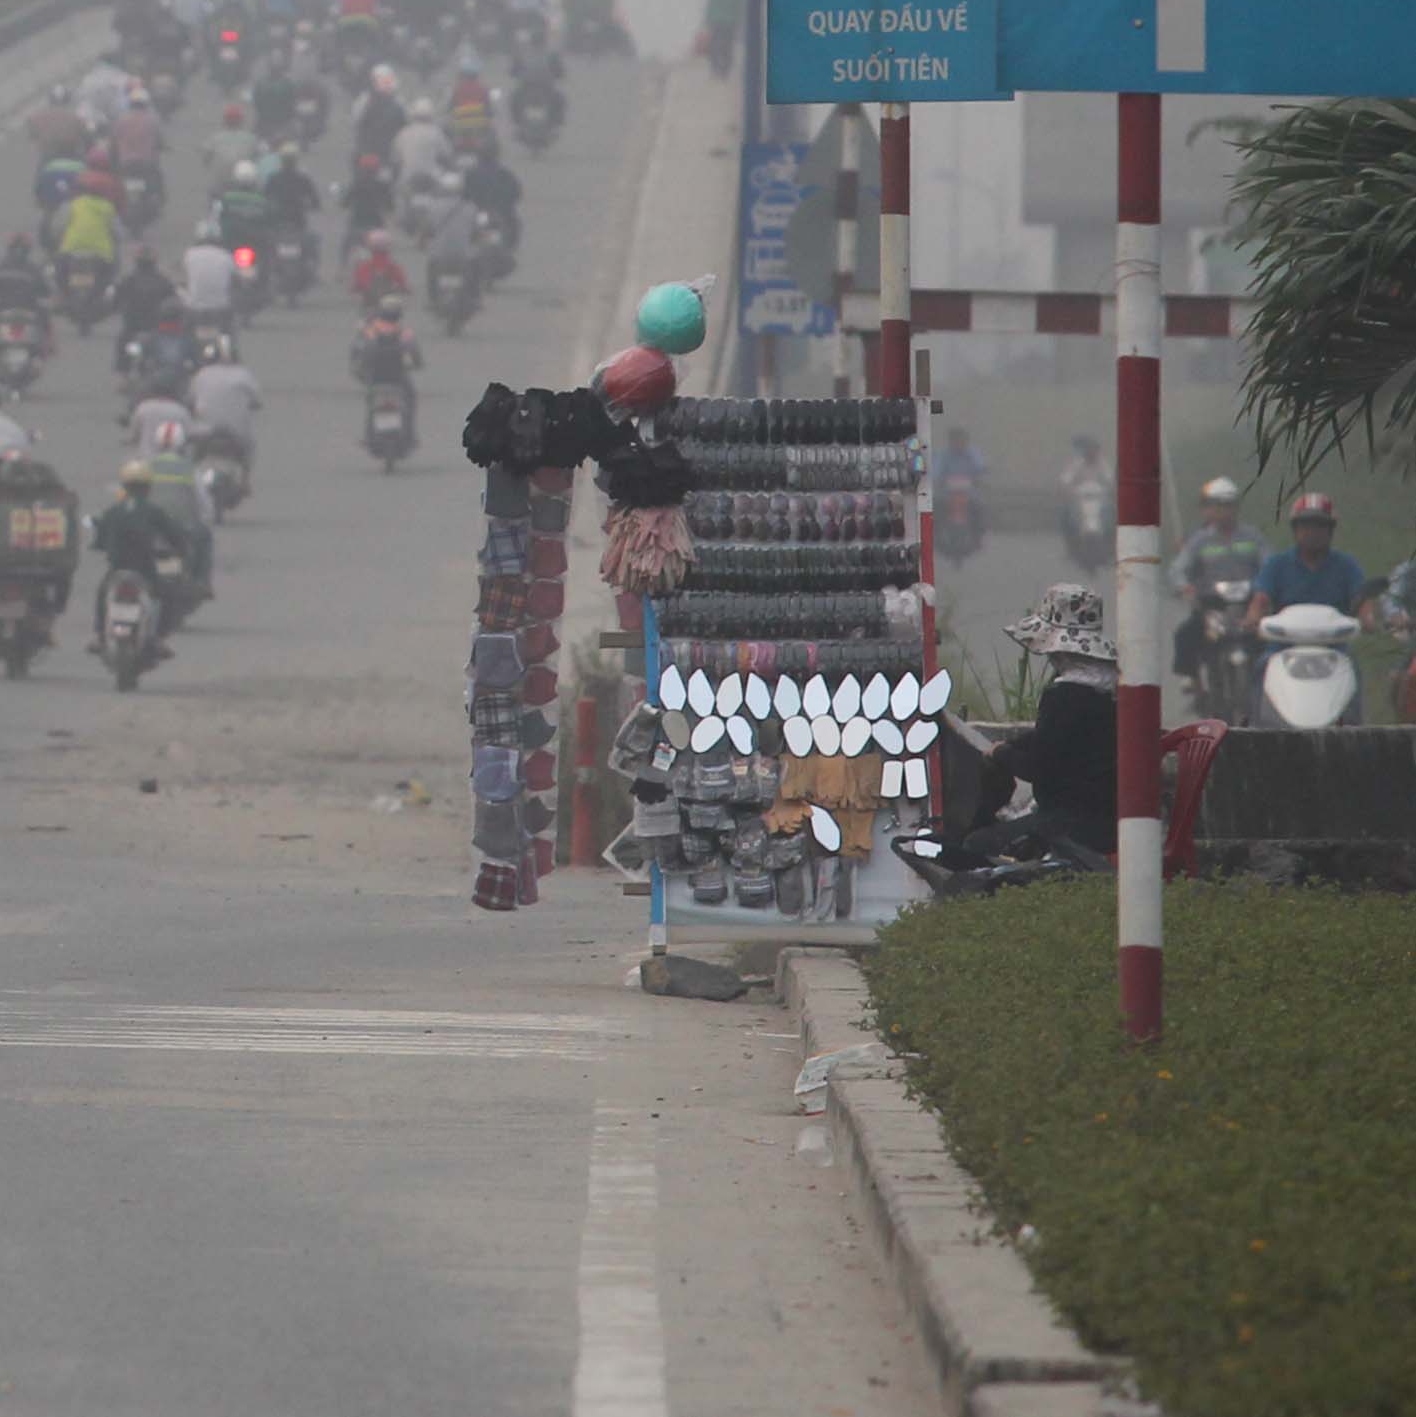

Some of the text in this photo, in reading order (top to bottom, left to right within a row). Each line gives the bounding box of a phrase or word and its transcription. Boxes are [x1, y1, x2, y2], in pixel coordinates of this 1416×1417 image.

[808, 8, 874, 36] QUAY
[832, 49, 949, 82] SUỐI TIÊN
